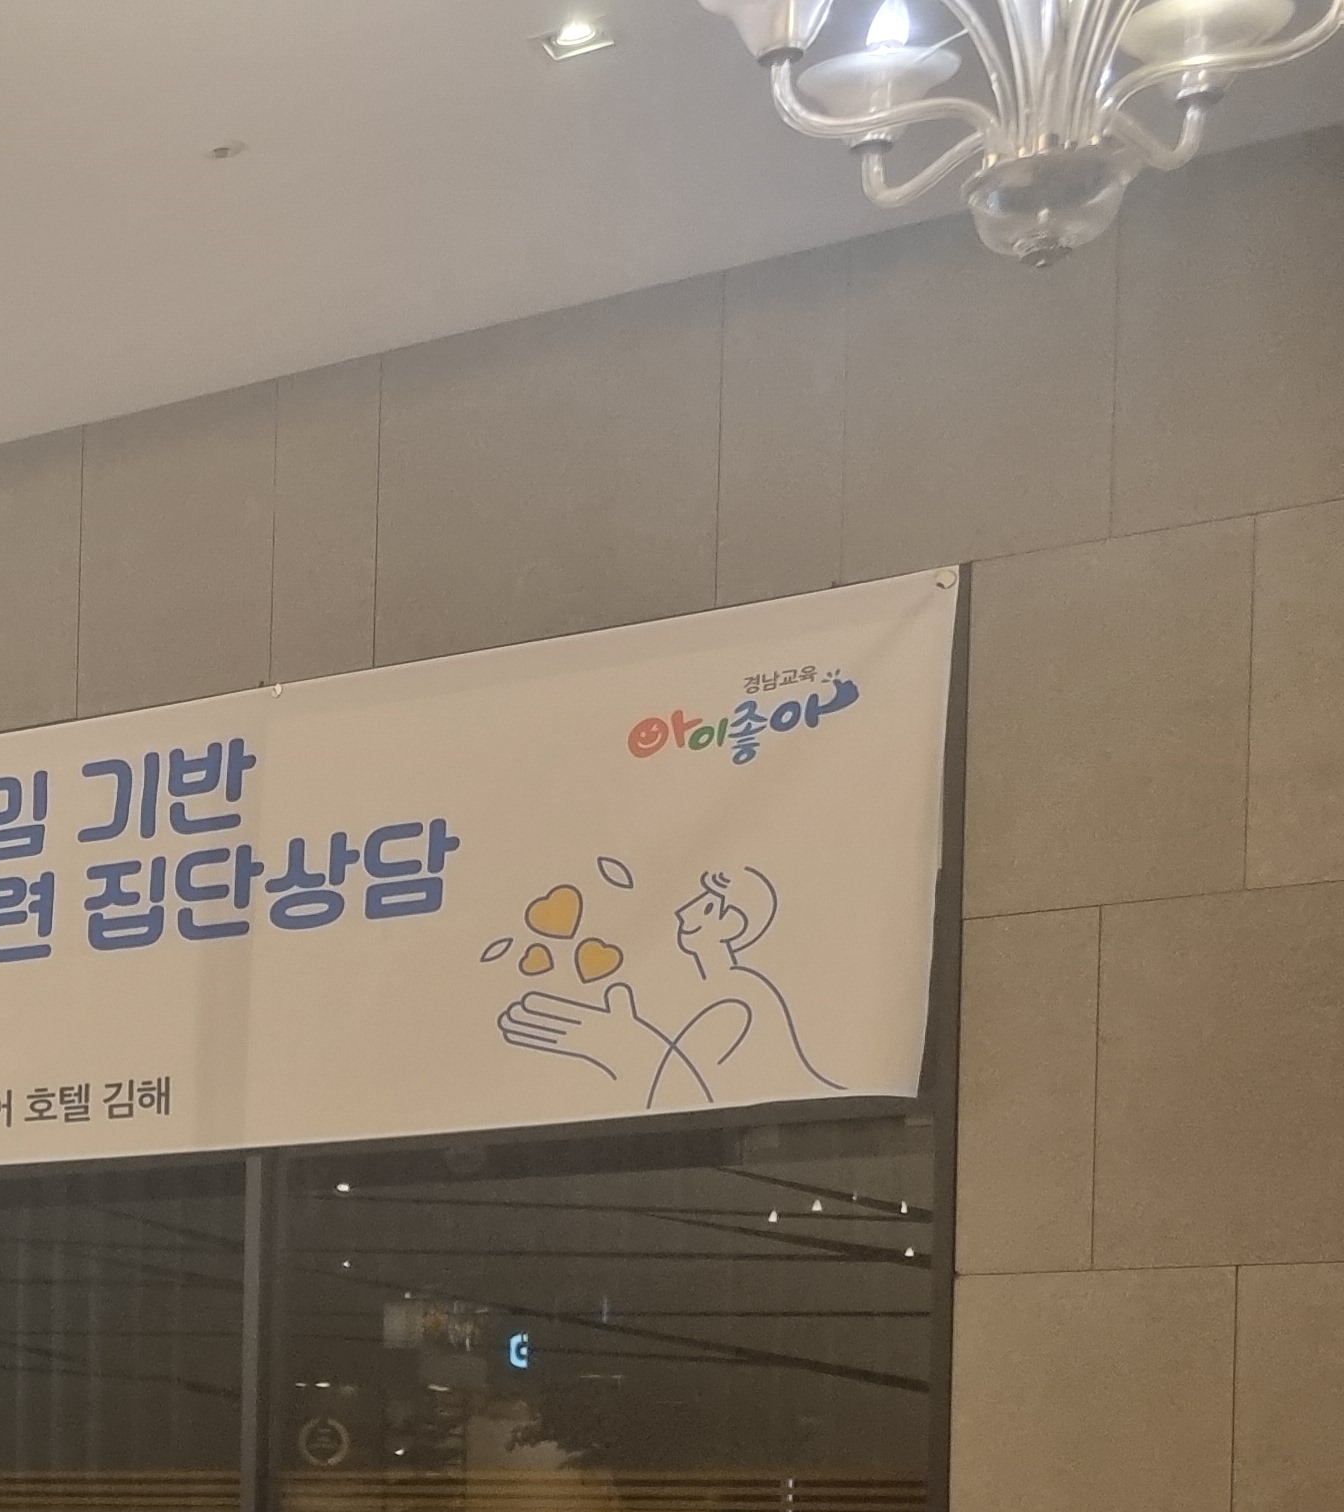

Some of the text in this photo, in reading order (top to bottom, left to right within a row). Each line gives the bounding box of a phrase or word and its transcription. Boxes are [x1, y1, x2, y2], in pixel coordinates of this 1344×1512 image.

[742, 665, 818, 694] 경남교육
[627, 682, 859, 765] 아이좋아
[78, 738, 256, 843] 기반
[84, 817, 460, 950] 집단상담
[24, 1083, 91, 1123] 호텔
[103, 1076, 170, 1119] 김해
